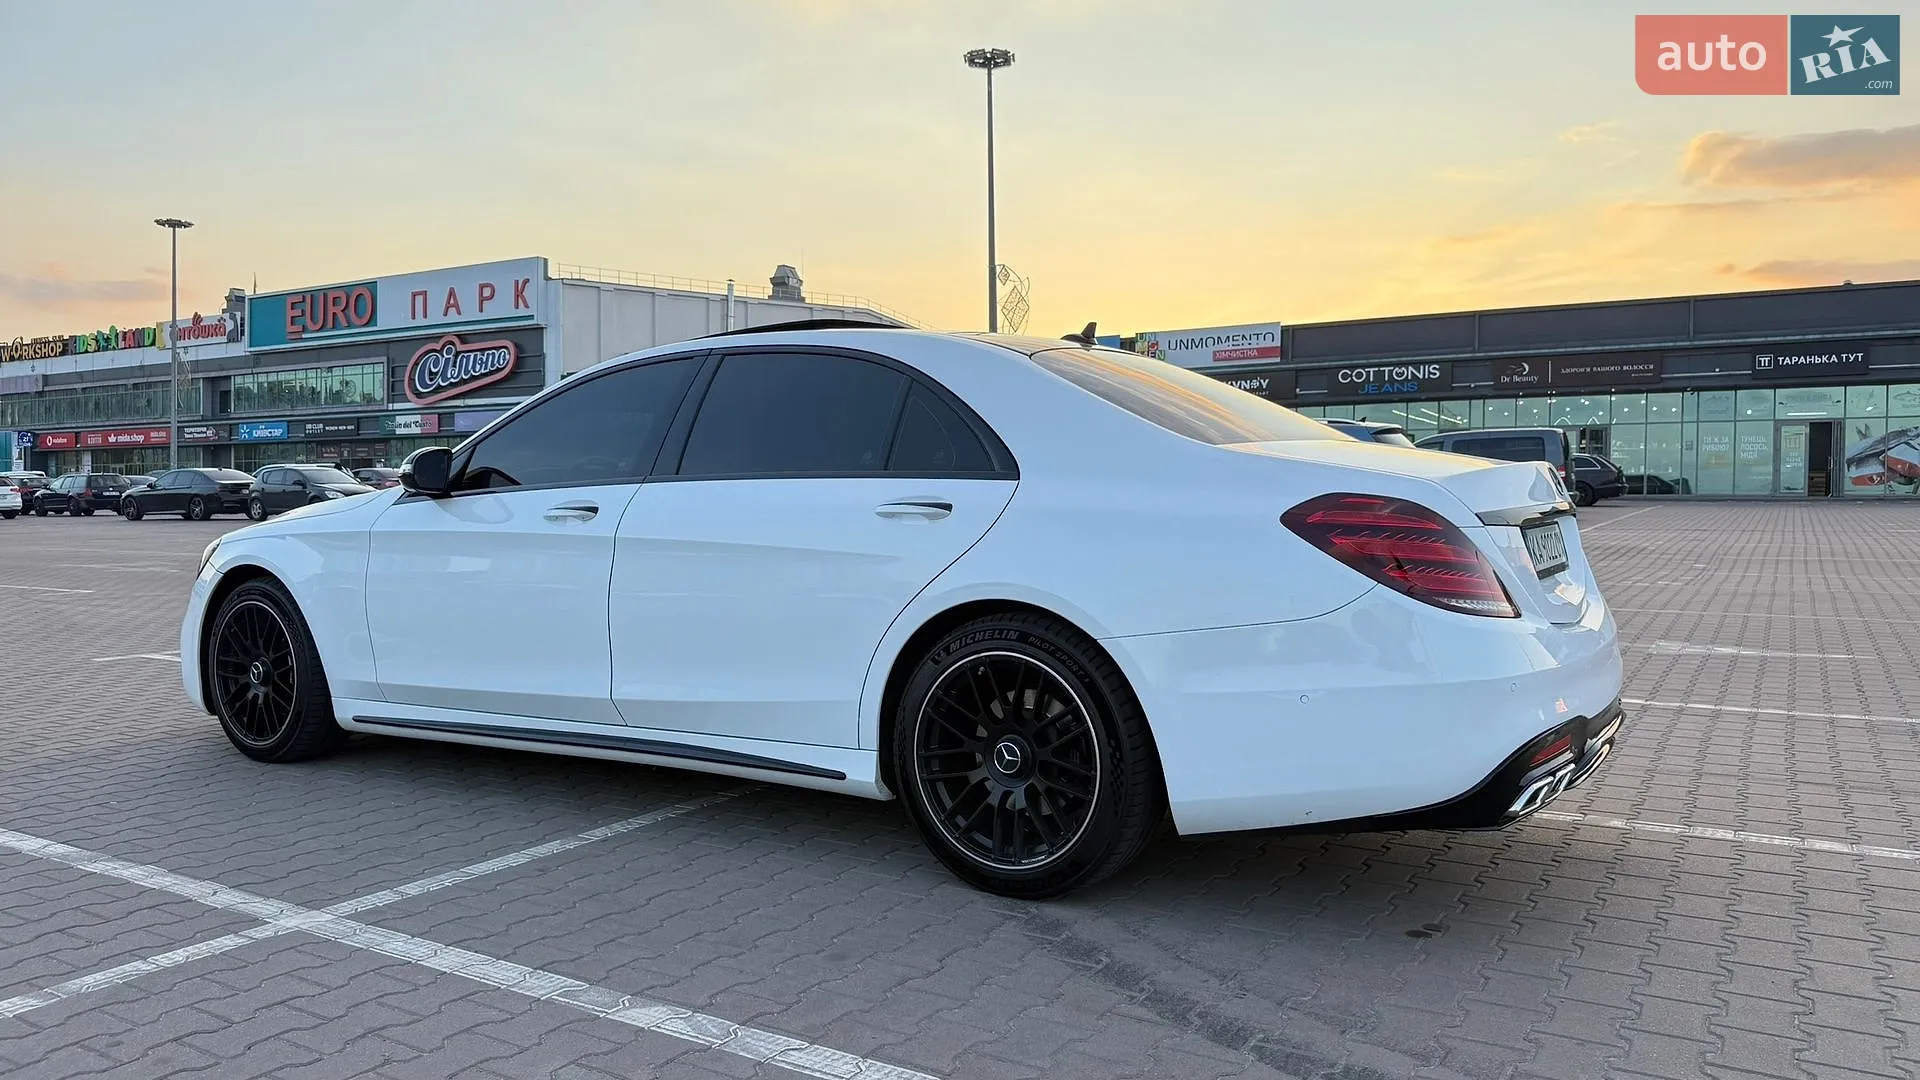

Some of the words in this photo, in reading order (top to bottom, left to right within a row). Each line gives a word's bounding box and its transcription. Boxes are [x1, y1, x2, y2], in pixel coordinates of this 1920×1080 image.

[286, 286, 375, 332] EURO
[410, 278, 530, 321] ПАРК
[68, 332, 97, 354] KIDS
[118, 327, 154, 349] LAND
[1168, 332, 1276, 351] UNMOMENTO
[1, 340, 63, 362] WORKSHOP
[1215, 349, 1259, 359] ХІМЧИСТКА
[1777, 354, 1838, 365] ТАРАНЬКА
[1841, 353, 1864, 362] ТУТ
[415, 344, 511, 392] Сільпо
[1338, 364, 1440, 383] COTTONIS
[1358, 381, 1418, 393] JEANS
[1501, 375, 1510, 383] Dr
[1513, 374, 1539, 384] Beauty
[949, 631, 1020, 651] MICHELIN
